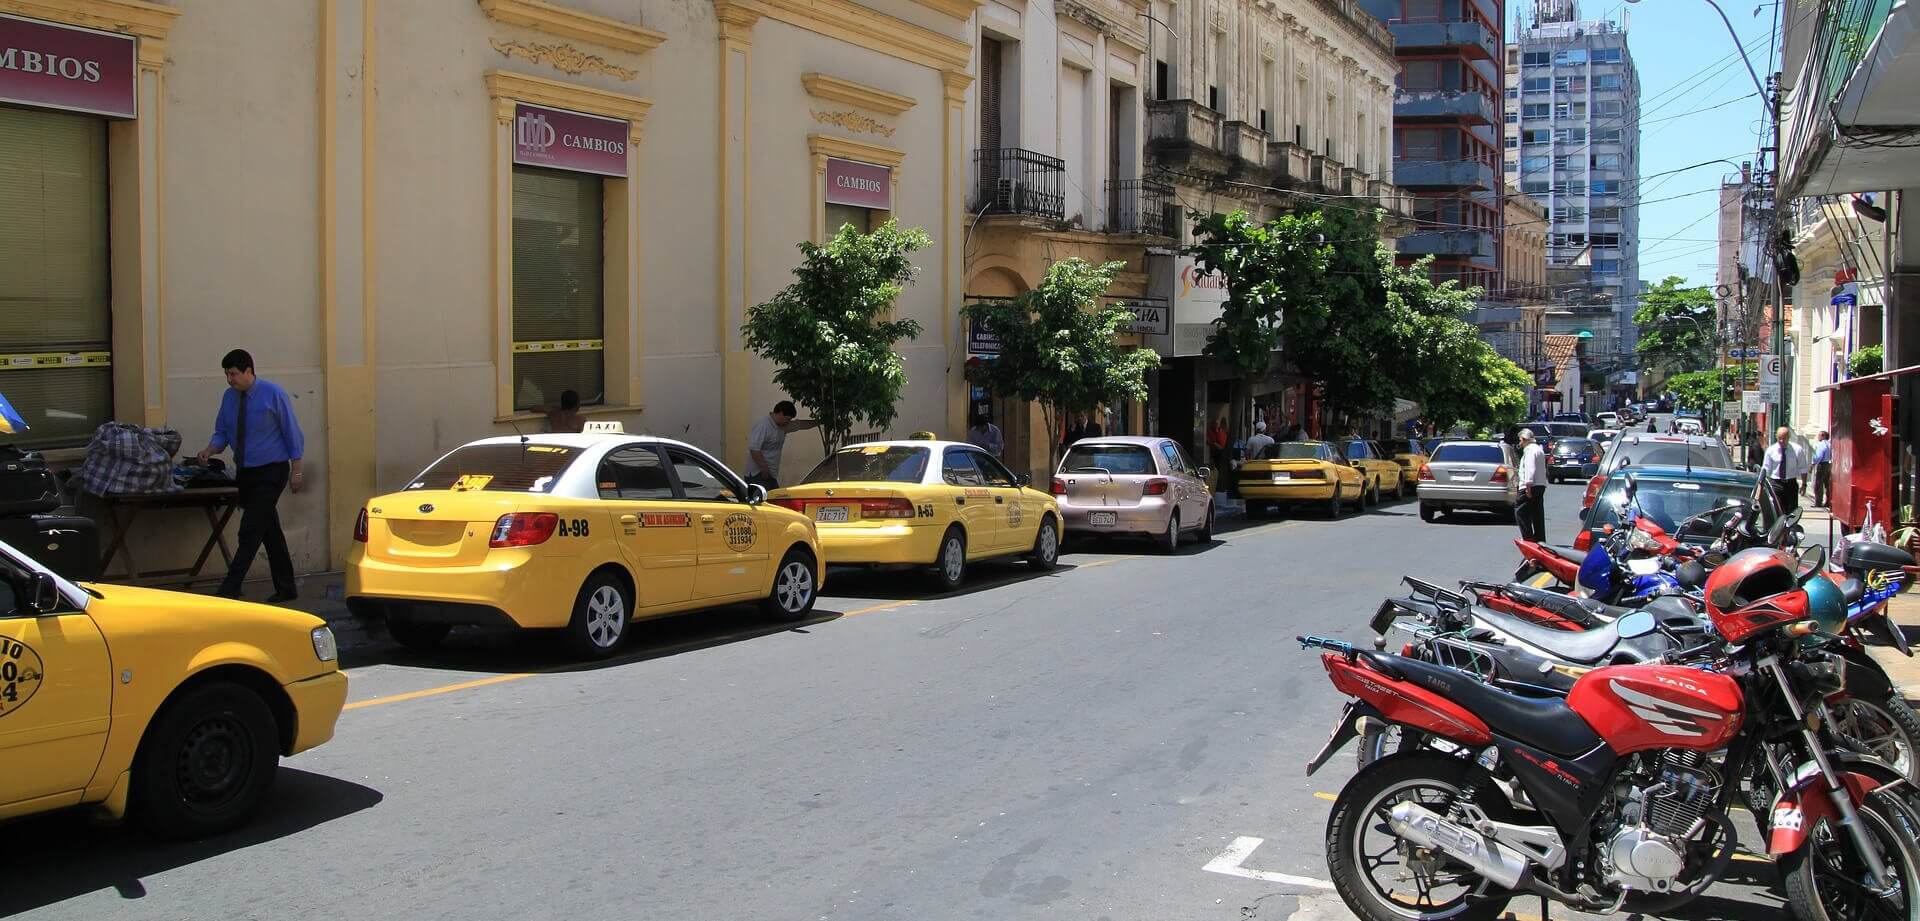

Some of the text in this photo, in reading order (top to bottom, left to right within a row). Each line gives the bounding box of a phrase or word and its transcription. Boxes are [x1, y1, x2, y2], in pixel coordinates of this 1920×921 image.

[563, 134, 624, 155] CAMBIOS
[836, 175, 881, 193] CAMBIOS
[976, 333, 1000, 341] CABIN
[589, 423, 617, 431] TAXI
[917, 505, 934, 518] A-63
[559, 519, 589, 537] A-98
[1427, 675, 1451, 692] TAIGA
[1656, 676, 1707, 695] TAIGA
